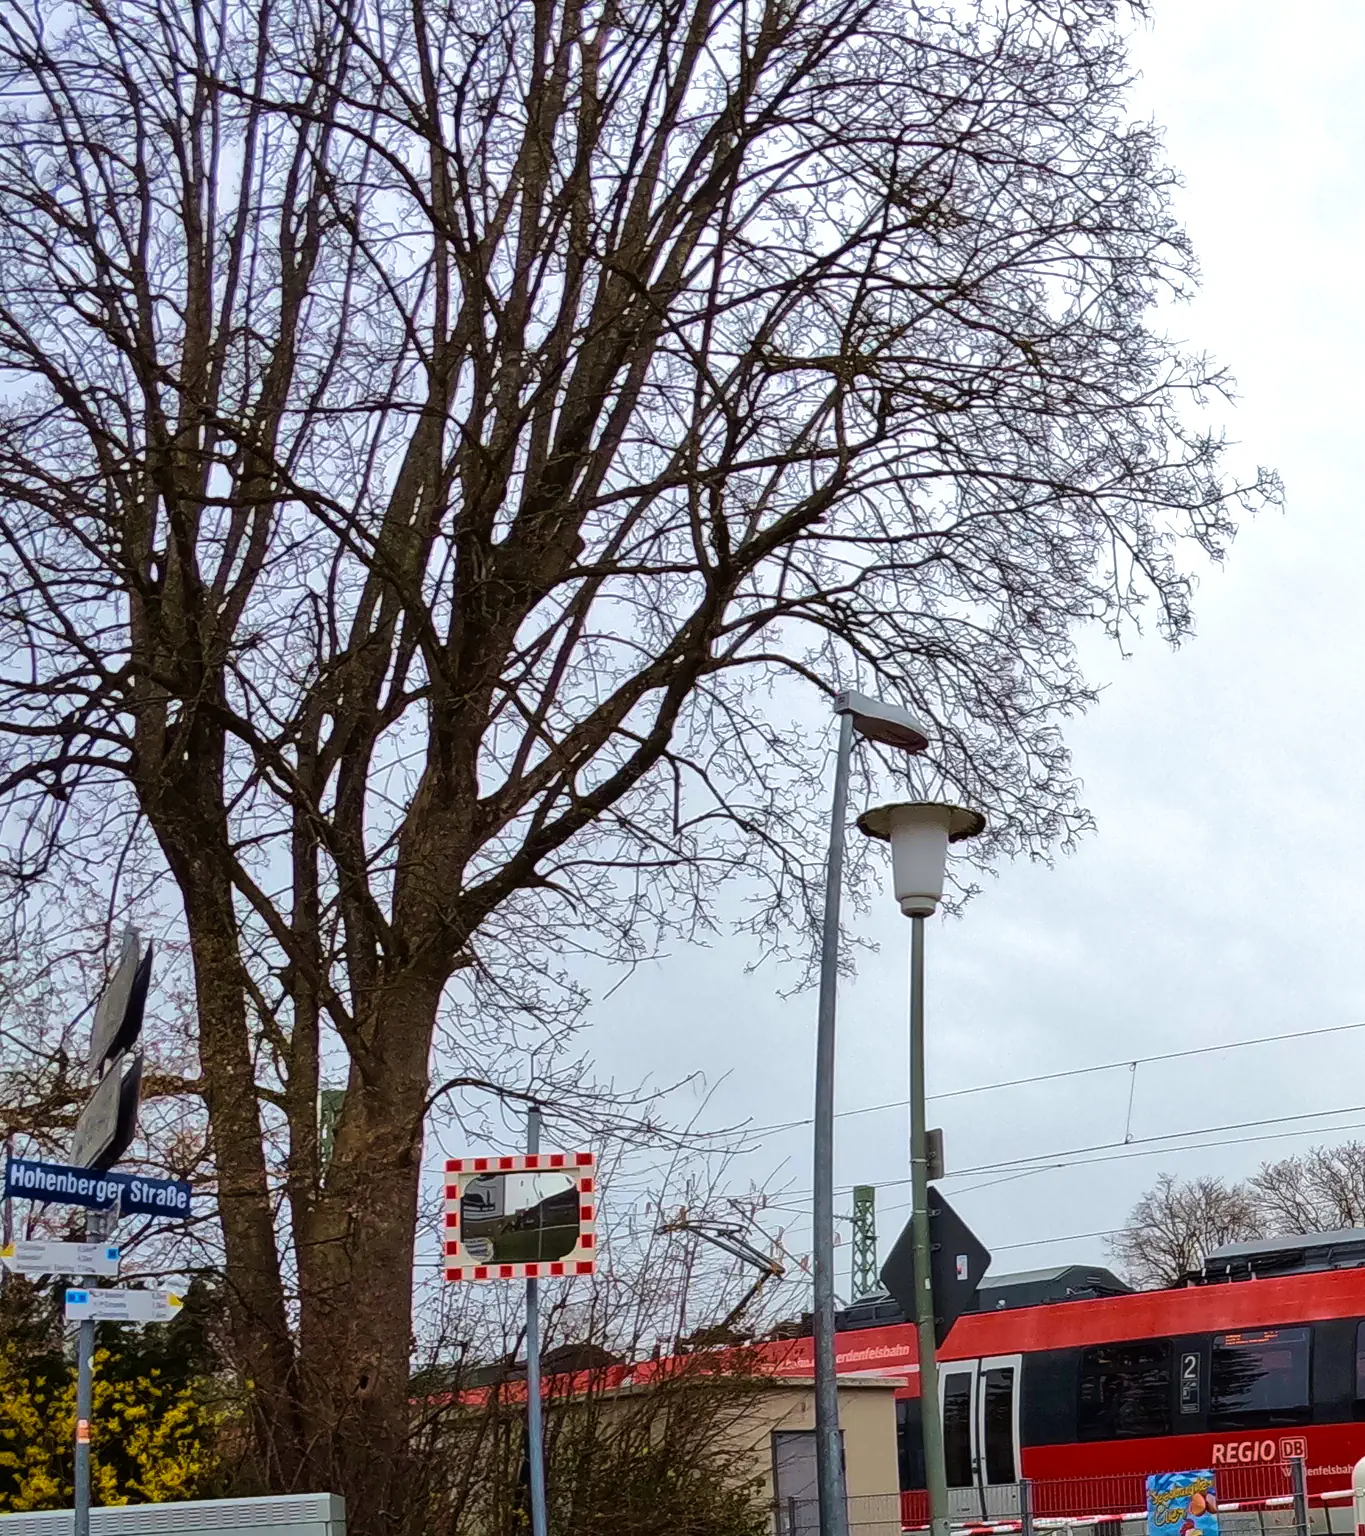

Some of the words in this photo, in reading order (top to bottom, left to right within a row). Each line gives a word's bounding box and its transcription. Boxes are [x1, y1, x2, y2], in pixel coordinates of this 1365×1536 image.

[11, 1164, 125, 1202] Hohenberger
[130, 1180, 187, 1209] Straße
[835, 1344, 910, 1364] erdenfelsbahn
[1184, 1356, 1196, 1378] 2
[1212, 1440, 1276, 1464] REGIO
[1282, 1440, 1305, 1458] DB
